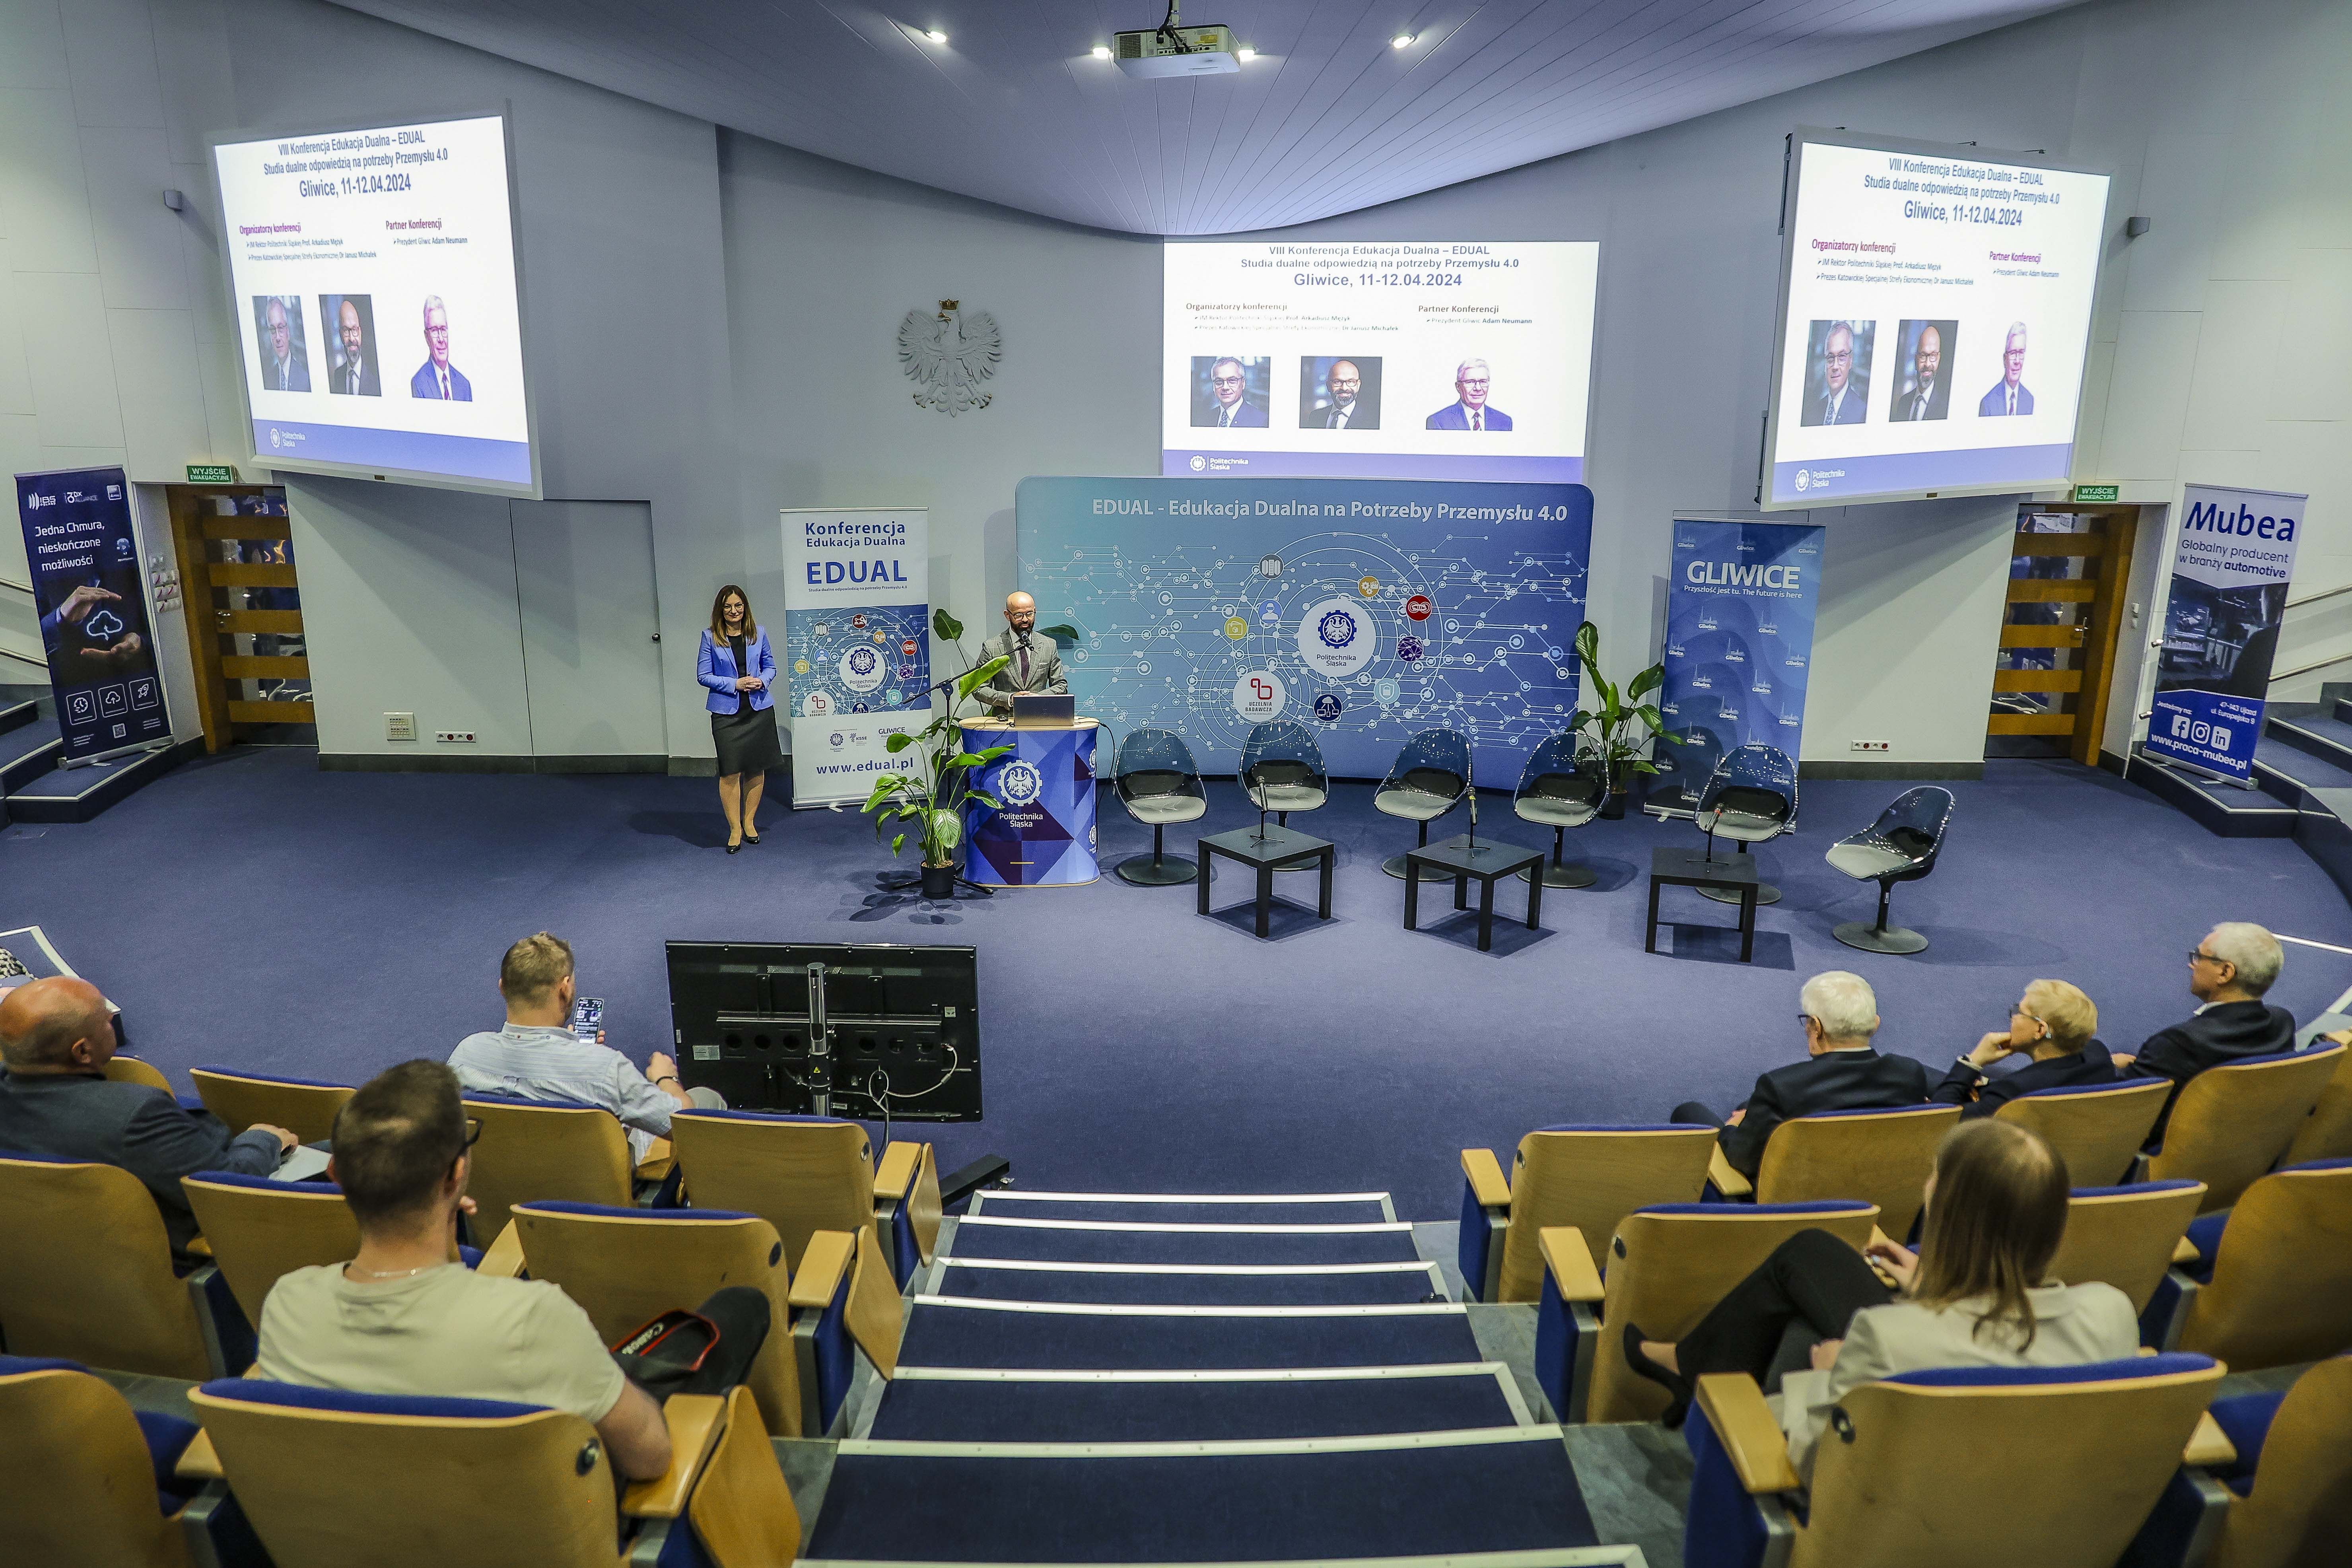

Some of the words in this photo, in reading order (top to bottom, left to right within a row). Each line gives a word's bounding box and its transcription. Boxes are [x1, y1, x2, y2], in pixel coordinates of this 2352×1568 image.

[278, 144, 289, 155] VIII
[290, 140, 330, 155] Konferencja
[332, 137, 363, 153] Edukacja
[365, 135, 390, 148] Dualna
[398, 130, 425, 144] EDUAL
[264, 163, 284, 175] Studia
[286, 161, 307, 173] dualne
[309, 157, 351, 173] odpowiedzią
[353, 158, 361, 167] na
[363, 153, 393, 169] potrzeby
[396, 150, 434, 165] Przemysłu
[437, 148, 447, 160] 4.0
[1889, 158, 1901, 171] VIII
[1904, 159, 1950, 178] Konferencja
[1952, 165, 1985, 182] Edukacja
[1988, 169, 2012, 182] Dualna
[2020, 172, 2043, 185] EDUAL
[300, 179, 338, 198] Gliwice,
[341, 173, 411, 194] 11-12.04.2024
[1864, 175, 1890, 189] Studia
[1893, 178, 1919, 191] dualne
[1921, 181, 1968, 199] odpowiedzią
[1970, 188, 1979, 197] na
[1981, 188, 2012, 203] potrzeby
[2013, 189, 2048, 205] Przemysłu
[2049, 193, 2059, 204] 4.0
[1905, 200, 1948, 223] Gliwice,
[1954, 204, 2022, 226] 11-12.04.2024
[240, 224, 272, 236] Organizatorzy
[273, 223, 301, 233] konferencji
[386, 221, 407, 230] Partner
[408, 218, 441, 230] Konferencji
[1289, 247, 1349, 256] Konferencja
[1353, 247, 1399, 256] Edukacja
[1812, 239, 1858, 253] Organizatorzy
[1860, 241, 1896, 255] konferencji
[1314, 259, 1377, 269] odpowiedzią
[1397, 259, 1441, 269] potrzeby
[1446, 259, 1499, 269] Przemysłu
[1990, 251, 2010, 260] Partner
[2011, 253, 2041, 264] Konferencji
[1295, 274, 1352, 287] Gliwice,
[1360, 274, 1462, 286] 11-12.04.2024
[1452, 305, 1499, 314] Konferencji
[1813, 469, 1845, 479] Politechnika
[1092, 499, 1155, 516] EDUAL
[1169, 499, 1249, 520] Edukacja
[1255, 499, 1319, 516] Dualna
[1324, 504, 1345, 517] na
[1351, 500, 1434, 523] Potrzeby
[1437, 503, 1534, 525] Przemysłu
[1538, 505, 1568, 521] 4.0
[35, 525, 64, 536] Jedna
[67, 522, 105, 532] Chmura,
[806, 521, 904, 536] Konferencja
[2185, 502, 2294, 542] Mubea
[39, 539, 100, 554] nieskończone
[807, 537, 859, 548] Edukacja
[865, 536, 905, 545] Dualna
[2182, 540, 2228, 557] Globalny
[2230, 548, 2288, 563] producent
[42, 555, 93, 571] możliwości
[2190, 554, 2223, 571] branży
[2224, 561, 2286, 578] automotive
[807, 560, 907, 584] EDUAL
[1686, 561, 1801, 589] GLIWICE
[1755, 589, 1778, 597] future
[2152, 734, 2247, 770] www.praca-mubea.pl
[816, 757, 913, 775] www.edual.pl
[1010, 820, 1032, 828] Śląska
